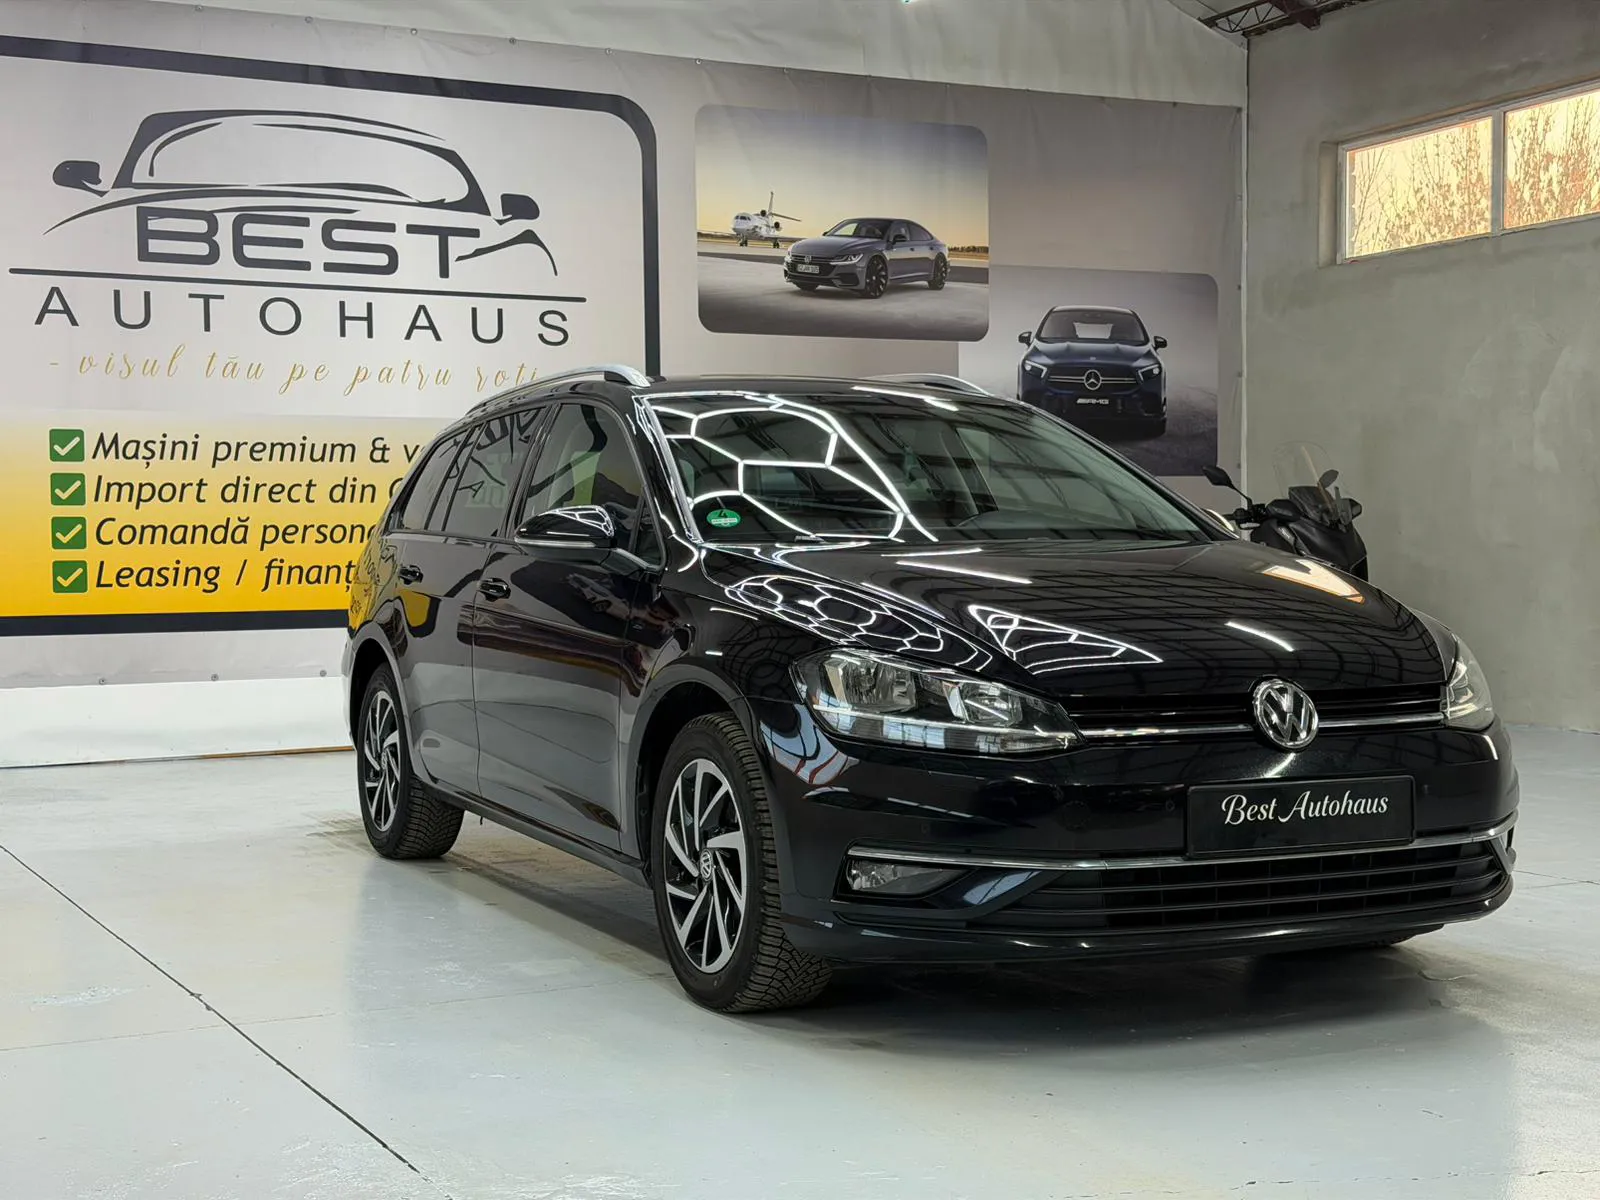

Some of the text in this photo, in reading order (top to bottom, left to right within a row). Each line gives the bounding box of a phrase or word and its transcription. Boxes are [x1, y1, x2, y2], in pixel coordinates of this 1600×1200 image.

[136, 205, 481, 279] BEST
[34, 286, 570, 347] AUTOHAUS
[78, 344, 185, 380] visul
[278, 362, 329, 395] pe
[343, 359, 451, 396] patru
[91, 432, 200, 470] Mașini
[211, 434, 357, 468] premium
[369, 437, 391, 463] &
[93, 475, 208, 510] Import
[220, 477, 316, 504] direct
[328, 476, 377, 503] din
[95, 516, 250, 546] Comandă
[95, 559, 221, 593] Leasing
[1221, 790, 1389, 826] Best Autohaus
